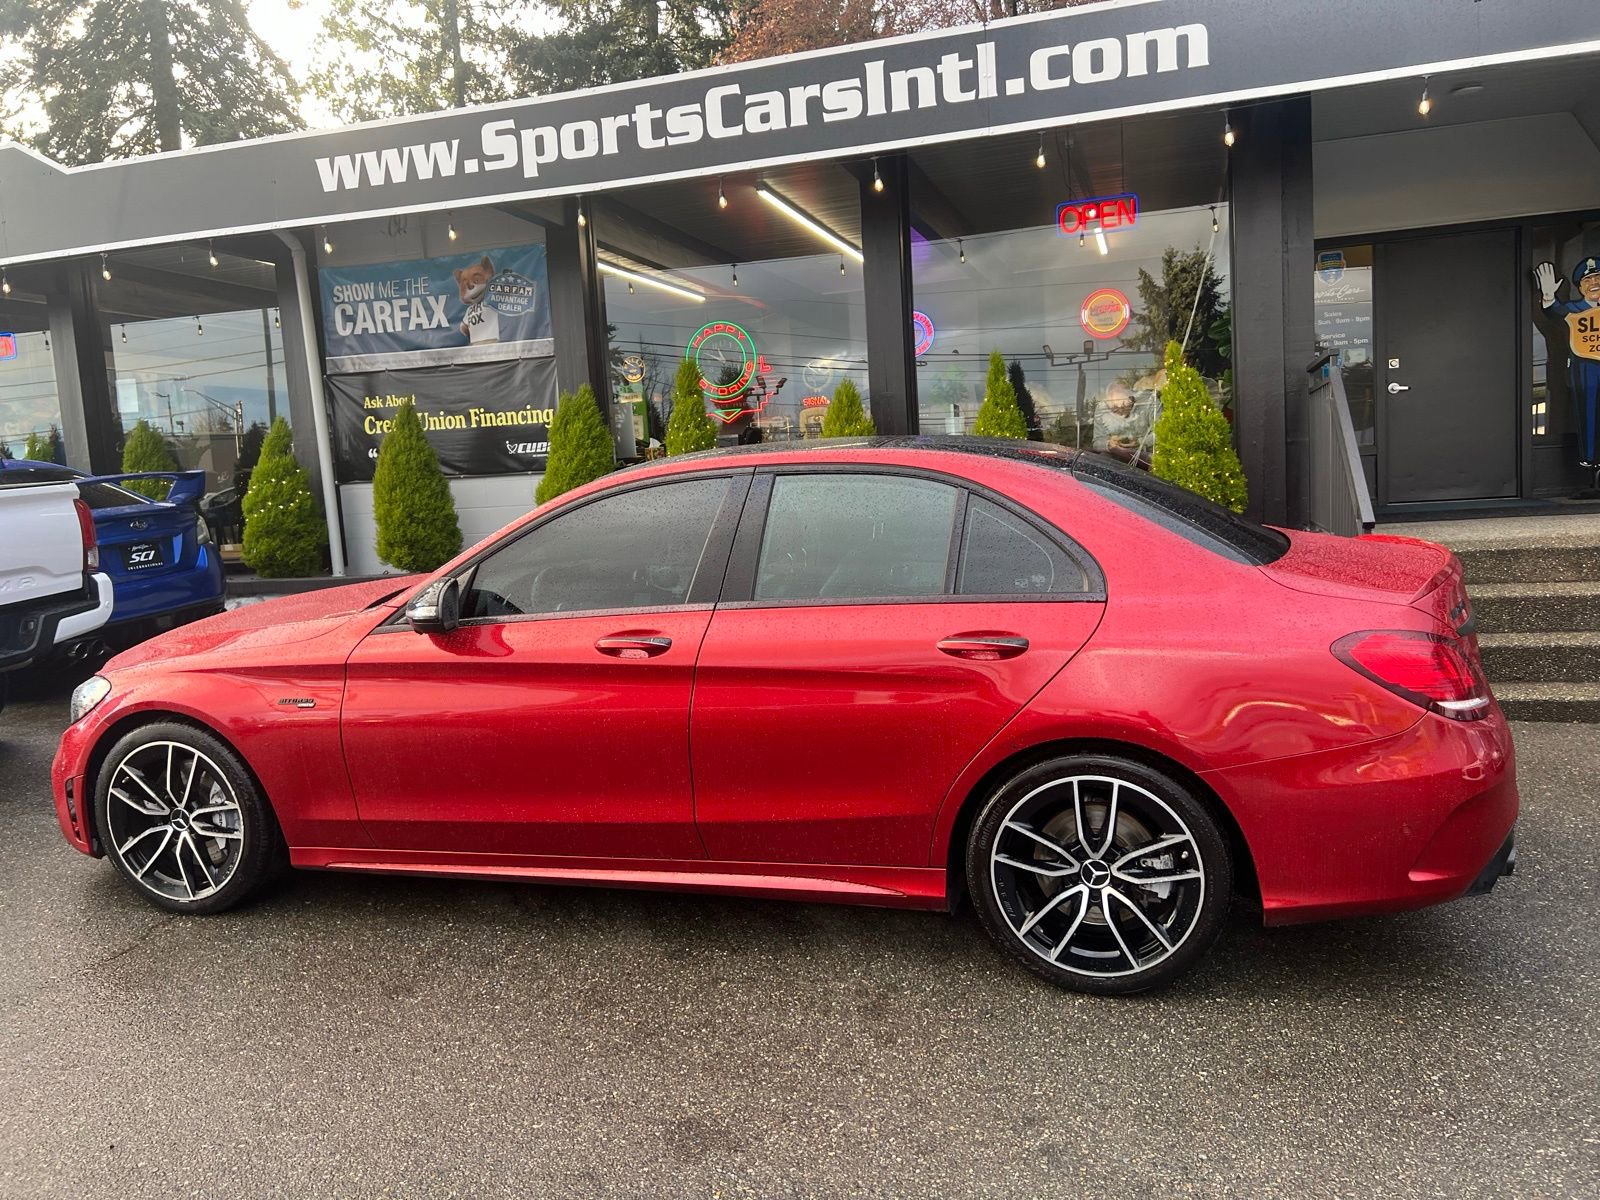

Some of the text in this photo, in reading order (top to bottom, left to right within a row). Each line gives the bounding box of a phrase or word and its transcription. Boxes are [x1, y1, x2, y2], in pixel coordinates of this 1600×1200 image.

[314, 22, 1210, 193] www.SportsCarsIntl.com
[1060, 199, 1136, 234] OPEN
[333, 276, 430, 303] SHOW ME THE
[489, 284, 532, 297] CARFAX
[490, 294, 529, 305] ADVANTAGE
[334, 294, 450, 337] CARFAX
[497, 302, 522, 312] DEALER
[692, 323, 747, 348] HAPPY
[364, 393, 416, 409] Ask Abot
[416, 411, 467, 432] Union
[469, 404, 554, 428] Financing
[129, 550, 155, 563] SCI
